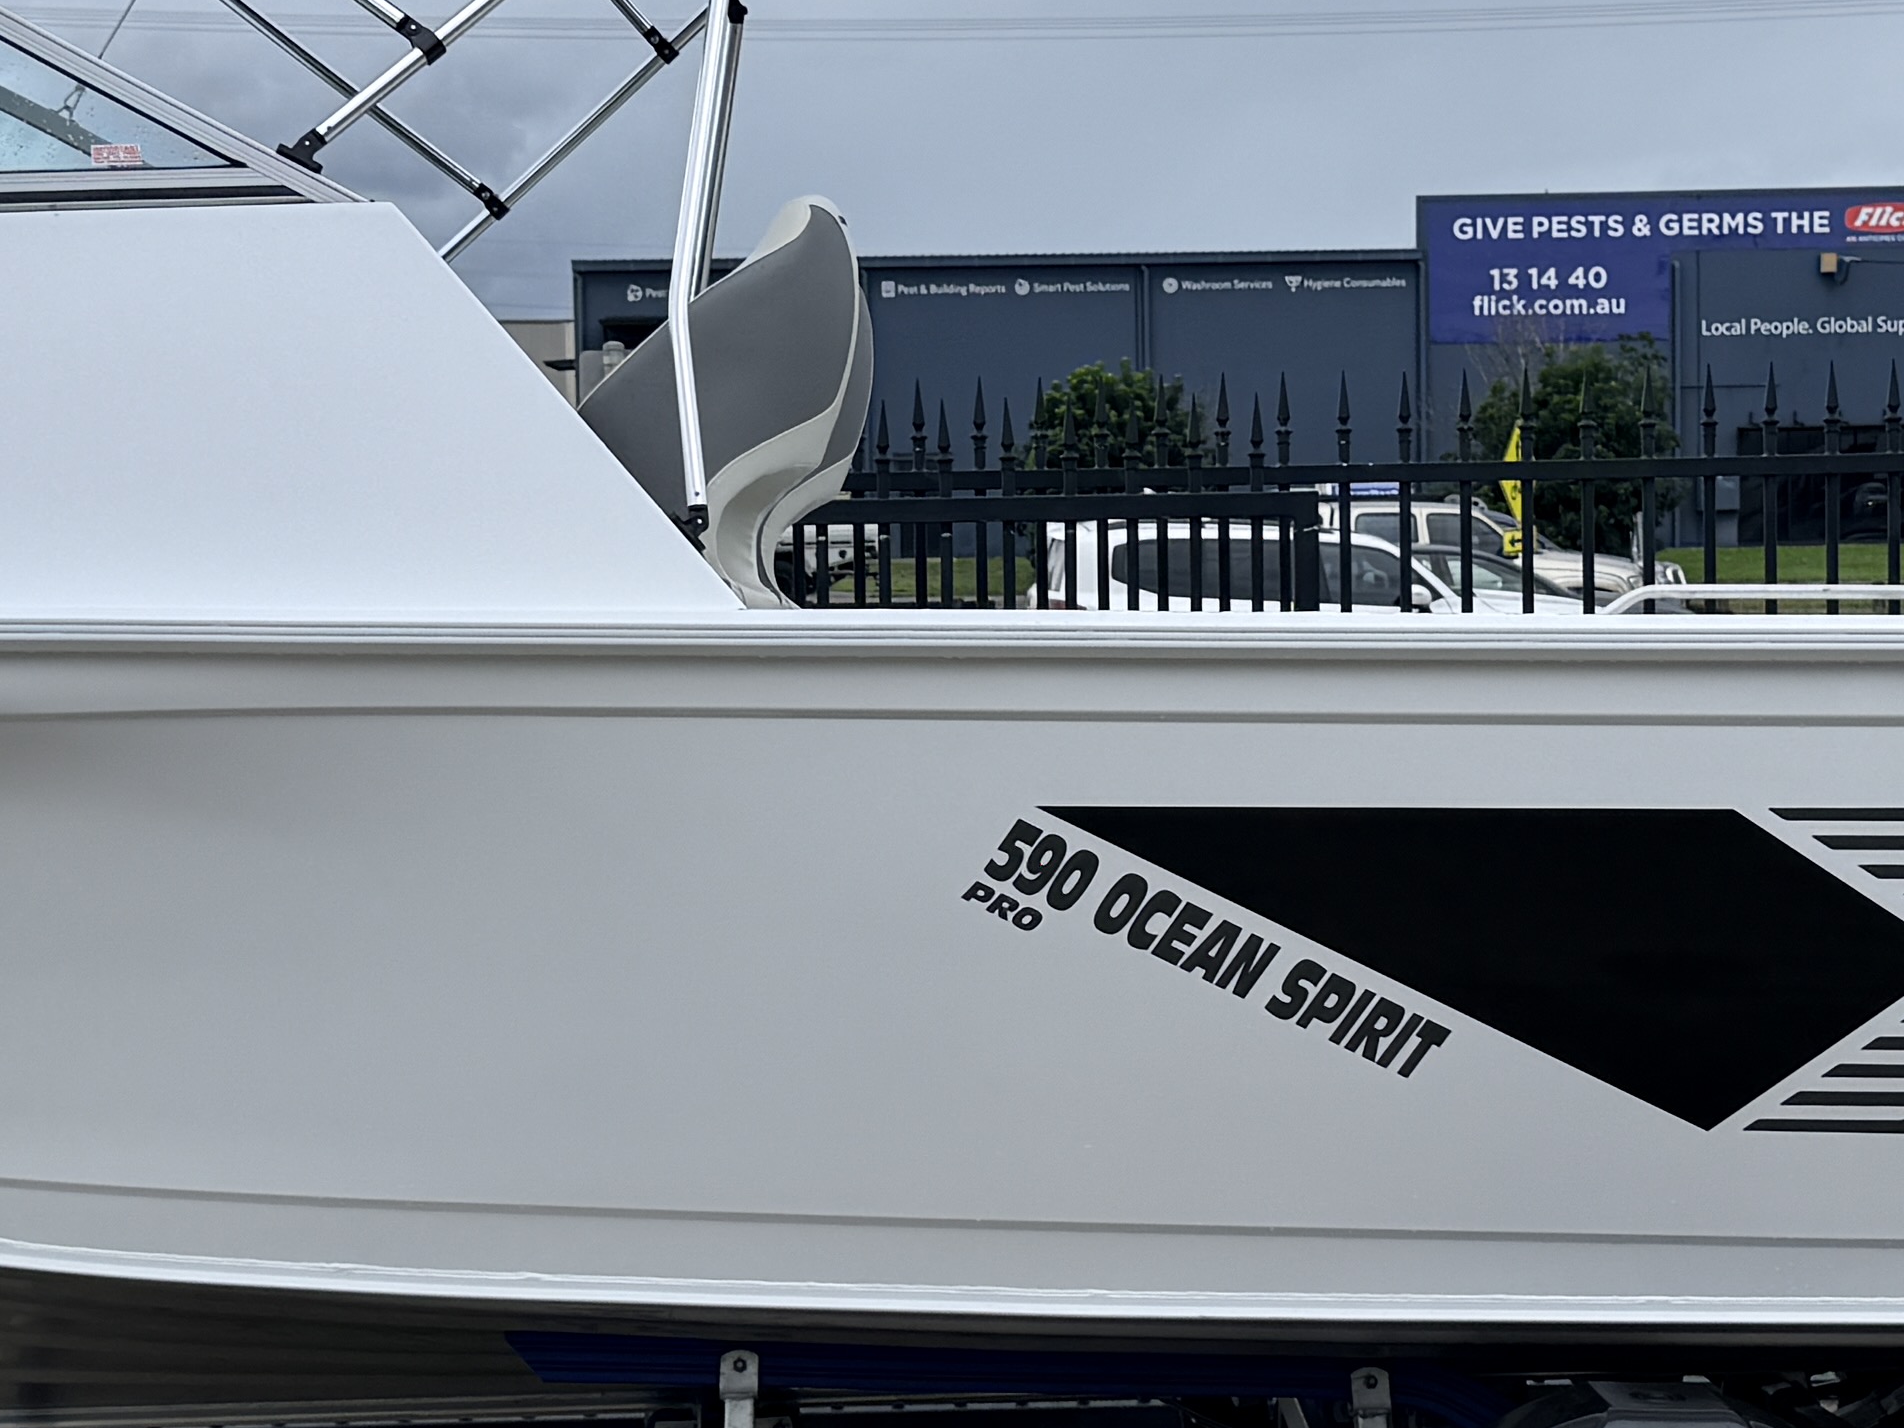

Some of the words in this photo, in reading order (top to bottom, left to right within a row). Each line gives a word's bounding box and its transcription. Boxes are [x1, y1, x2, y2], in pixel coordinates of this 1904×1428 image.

[1452, 216, 1526, 241] GIVE
[1531, 214, 1625, 239] PESTS
[1631, 213, 1652, 237] &
[1658, 211, 1765, 236] GERMS
[1770, 210, 1831, 234] THE
[968, 282, 1006, 296] Reports
[1032, 281, 1062, 293] Smart
[1063, 281, 1085, 293] Pest
[1085, 280, 1130, 293] Solutions
[1181, 279, 1232, 291] Washroom
[1232, 278, 1273, 290] Services
[1303, 278, 1342, 291] Hygiene
[1342, 277, 1407, 289] Consumables
[1489, 267, 1519, 291] 13
[1527, 266, 1559, 290] 14
[1567, 265, 1608, 289] 40
[1472, 294, 1627, 316] flick.com.au
[1700, 318, 1746, 337] Local
[1749, 317, 1814, 338] People.
[1816, 315, 1873, 334] Global
[960, 880, 1045, 932] PRO
[983, 818, 1099, 911] 590
[1093, 872, 1282, 1000] OCEAN
[1263, 958, 1453, 1079] SPIRIT
